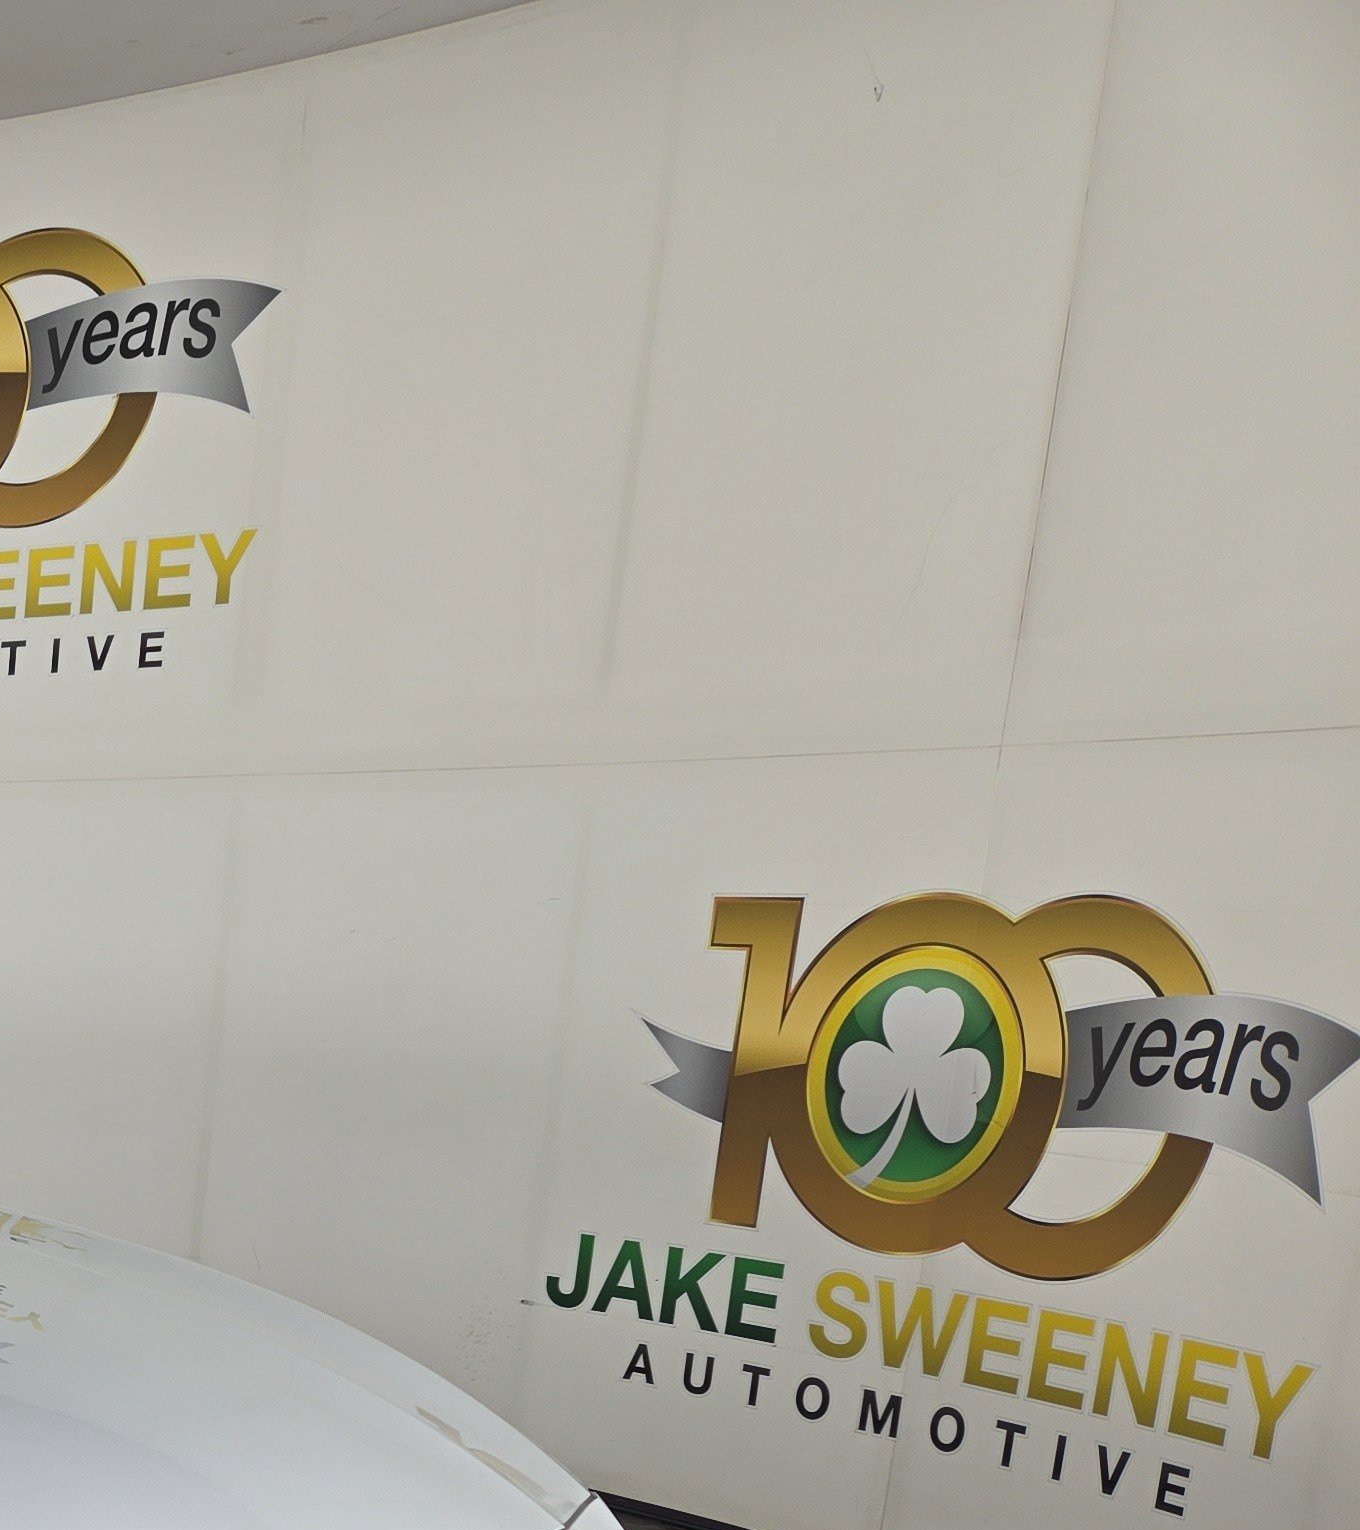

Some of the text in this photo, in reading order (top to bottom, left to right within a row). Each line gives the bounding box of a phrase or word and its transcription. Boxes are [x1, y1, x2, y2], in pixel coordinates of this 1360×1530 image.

[41, 296, 221, 394] years
[707, 893, 1300, 1281] 100 years
[545, 1232, 1314, 1461] JAKE SWEENEY
[622, 1342, 1191, 1518] AUTOMOTIVE
